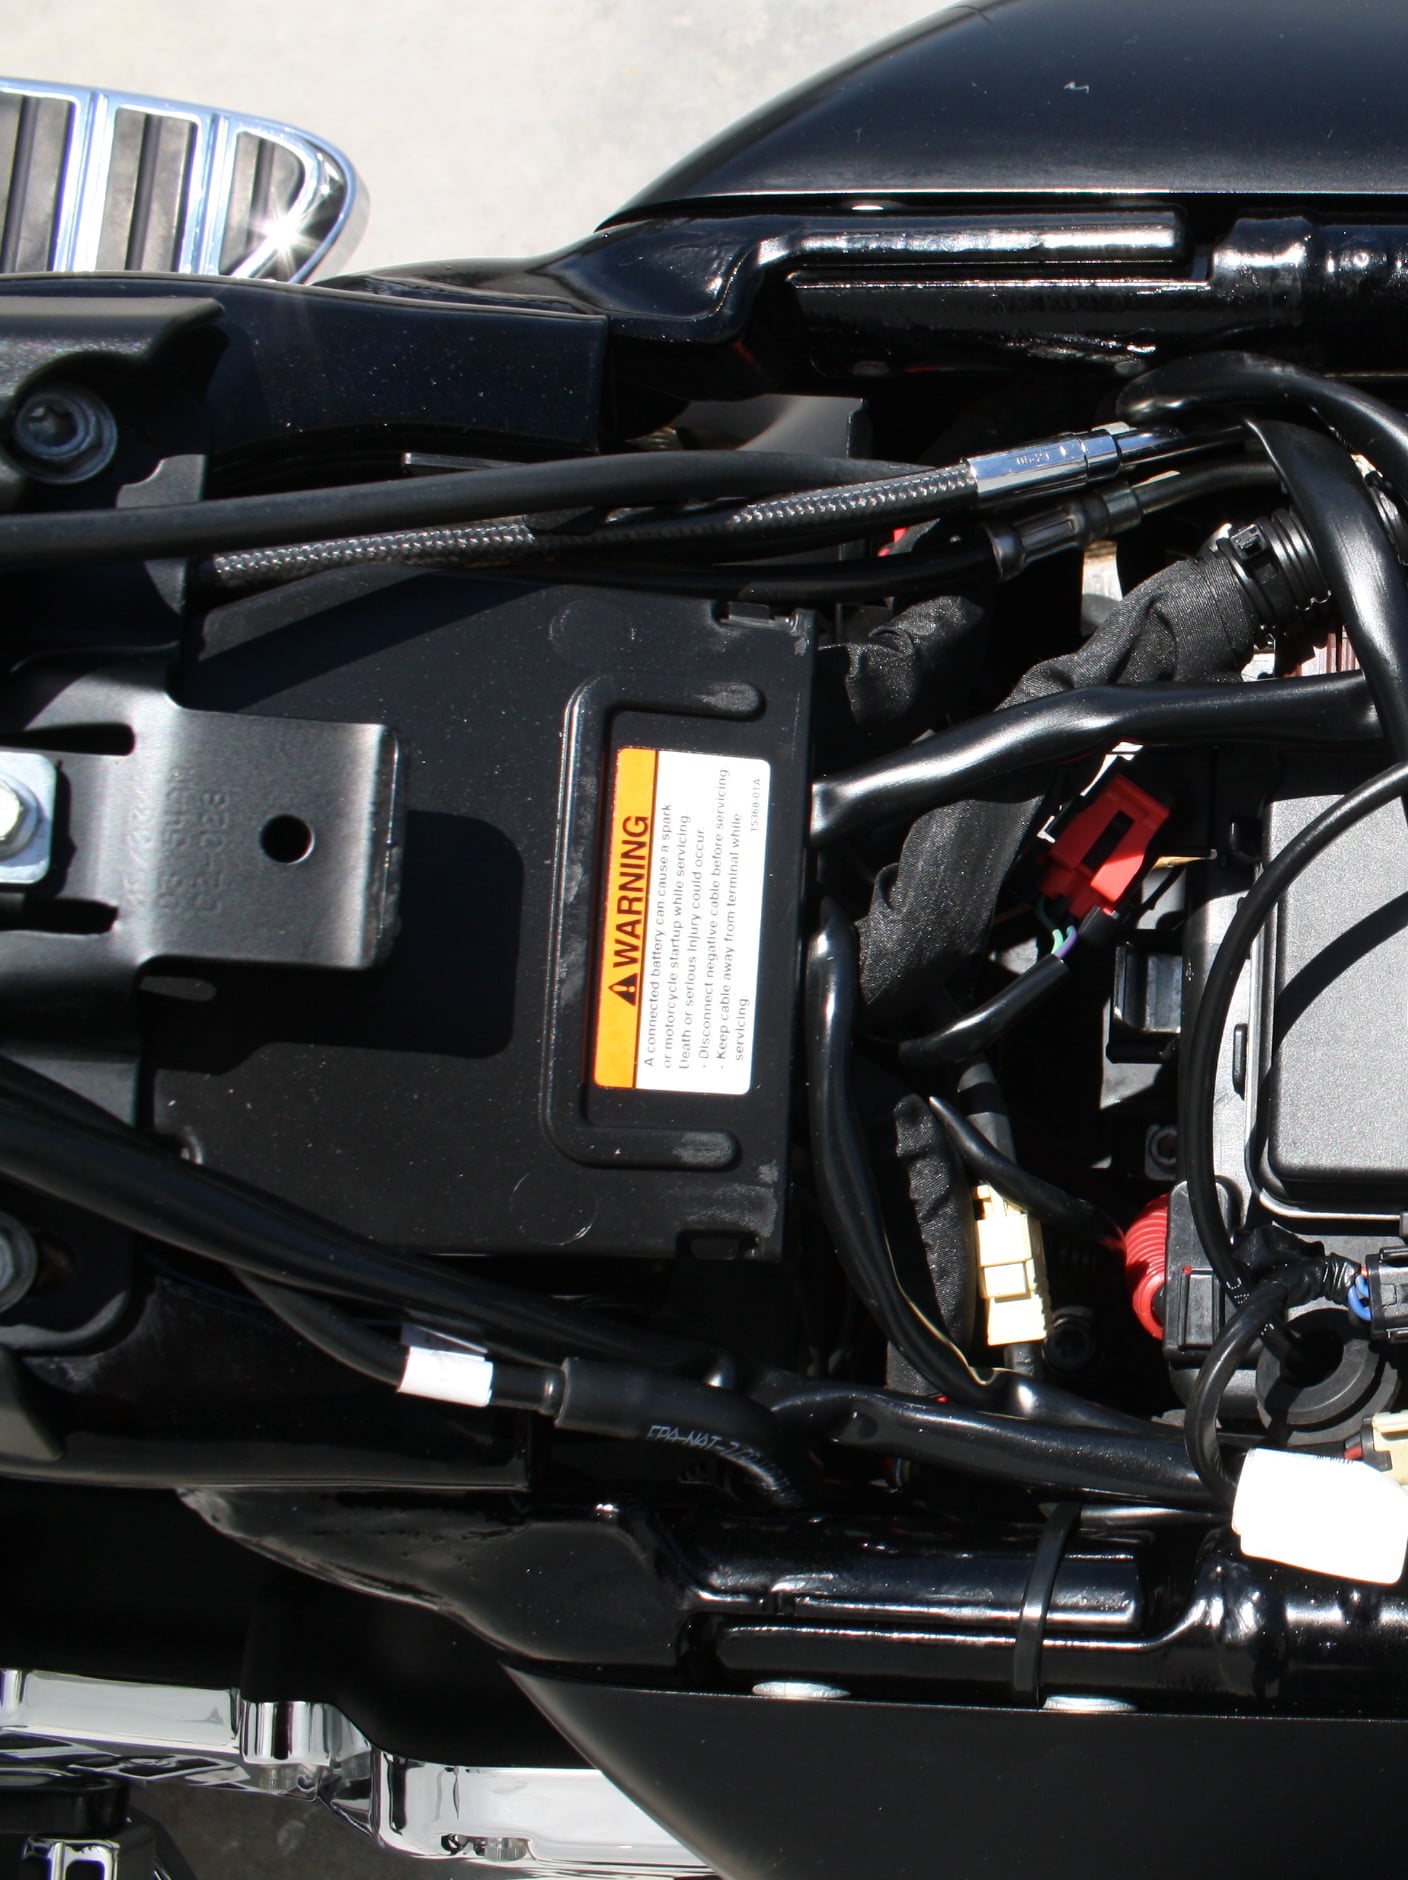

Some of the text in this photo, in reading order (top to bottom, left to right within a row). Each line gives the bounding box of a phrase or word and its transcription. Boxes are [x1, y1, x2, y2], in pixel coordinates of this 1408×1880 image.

[660, 803, 672, 840] spark
[657, 855, 668, 897] cause
[710, 833, 723, 876] before
[614, 815, 648, 968] WARNING
[655, 900, 665, 925] can
[671, 880, 684, 916] while
[690, 870, 702, 909] could
[708, 880, 720, 916] cable
[649, 929, 665, 977] battery
[668, 919, 684, 968] startup
[686, 913, 702, 952] injury
[705, 919, 718, 978] negative
[715, 813, 741, 1059] Keep cable away from terminal while
[684, 955, 696, 1006] serious
[646, 980, 660, 1053] connected
[664, 972, 679, 1050] motorcycle
[697, 982, 713, 1059] Disconnect
